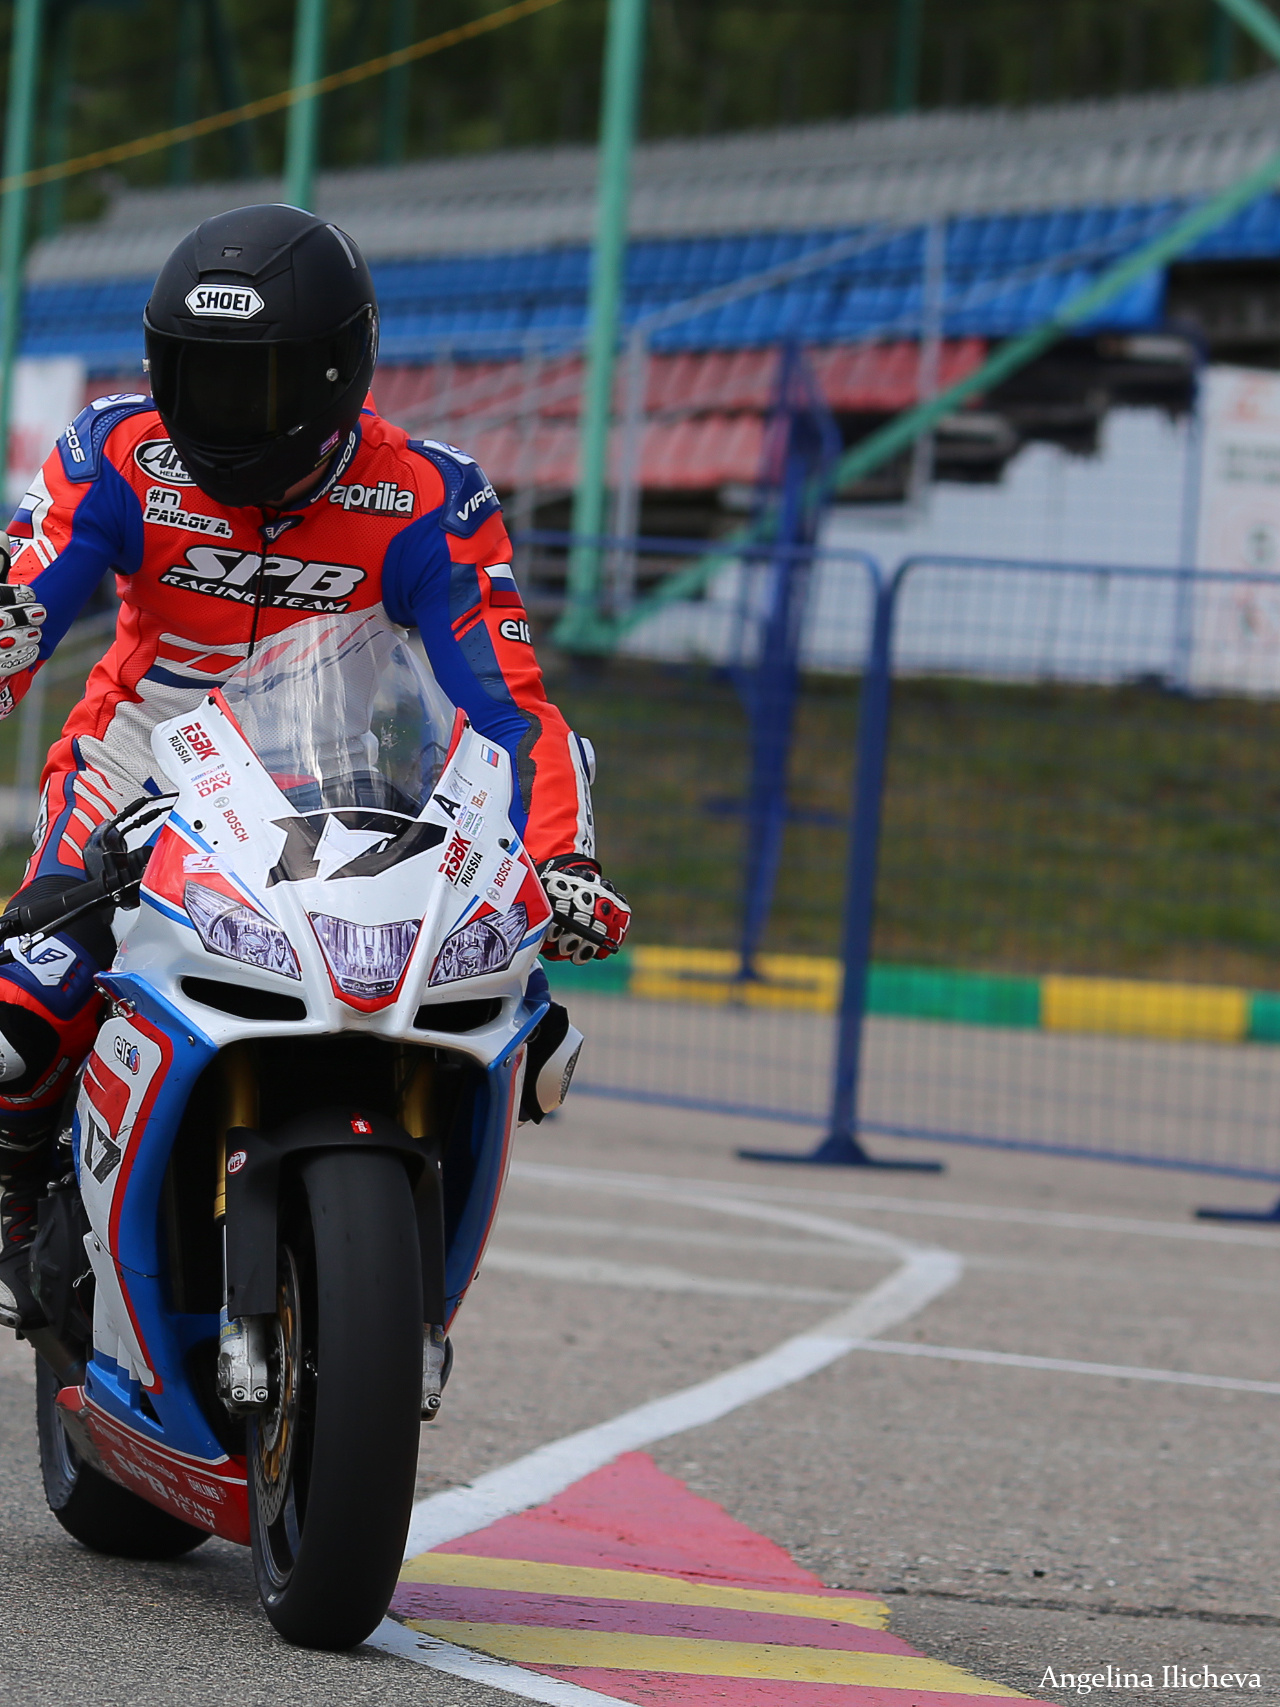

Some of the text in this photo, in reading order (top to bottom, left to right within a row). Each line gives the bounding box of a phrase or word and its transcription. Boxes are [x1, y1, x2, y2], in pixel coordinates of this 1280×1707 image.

[195, 291, 252, 312] SHOEI
[329, 481, 415, 513] aprilia
[145, 507, 230, 536] PAVLOV A.
[170, 546, 365, 599] SPB
[160, 574, 348, 613] RACING TEAM
[167, 734, 193, 766] RUSSIA
[193, 770, 230, 790] TRACK
[197, 775, 233, 799] DAY
[432, 793, 461, 821] A
[222, 808, 250, 843] BOSCH
[460, 850, 484, 888] RUSSIA
[493, 856, 514, 888] BOSCH
[111, 1449, 170, 1500] SPB
[168, 1485, 216, 1519] RACING
[172, 1496, 216, 1530] TEAM
